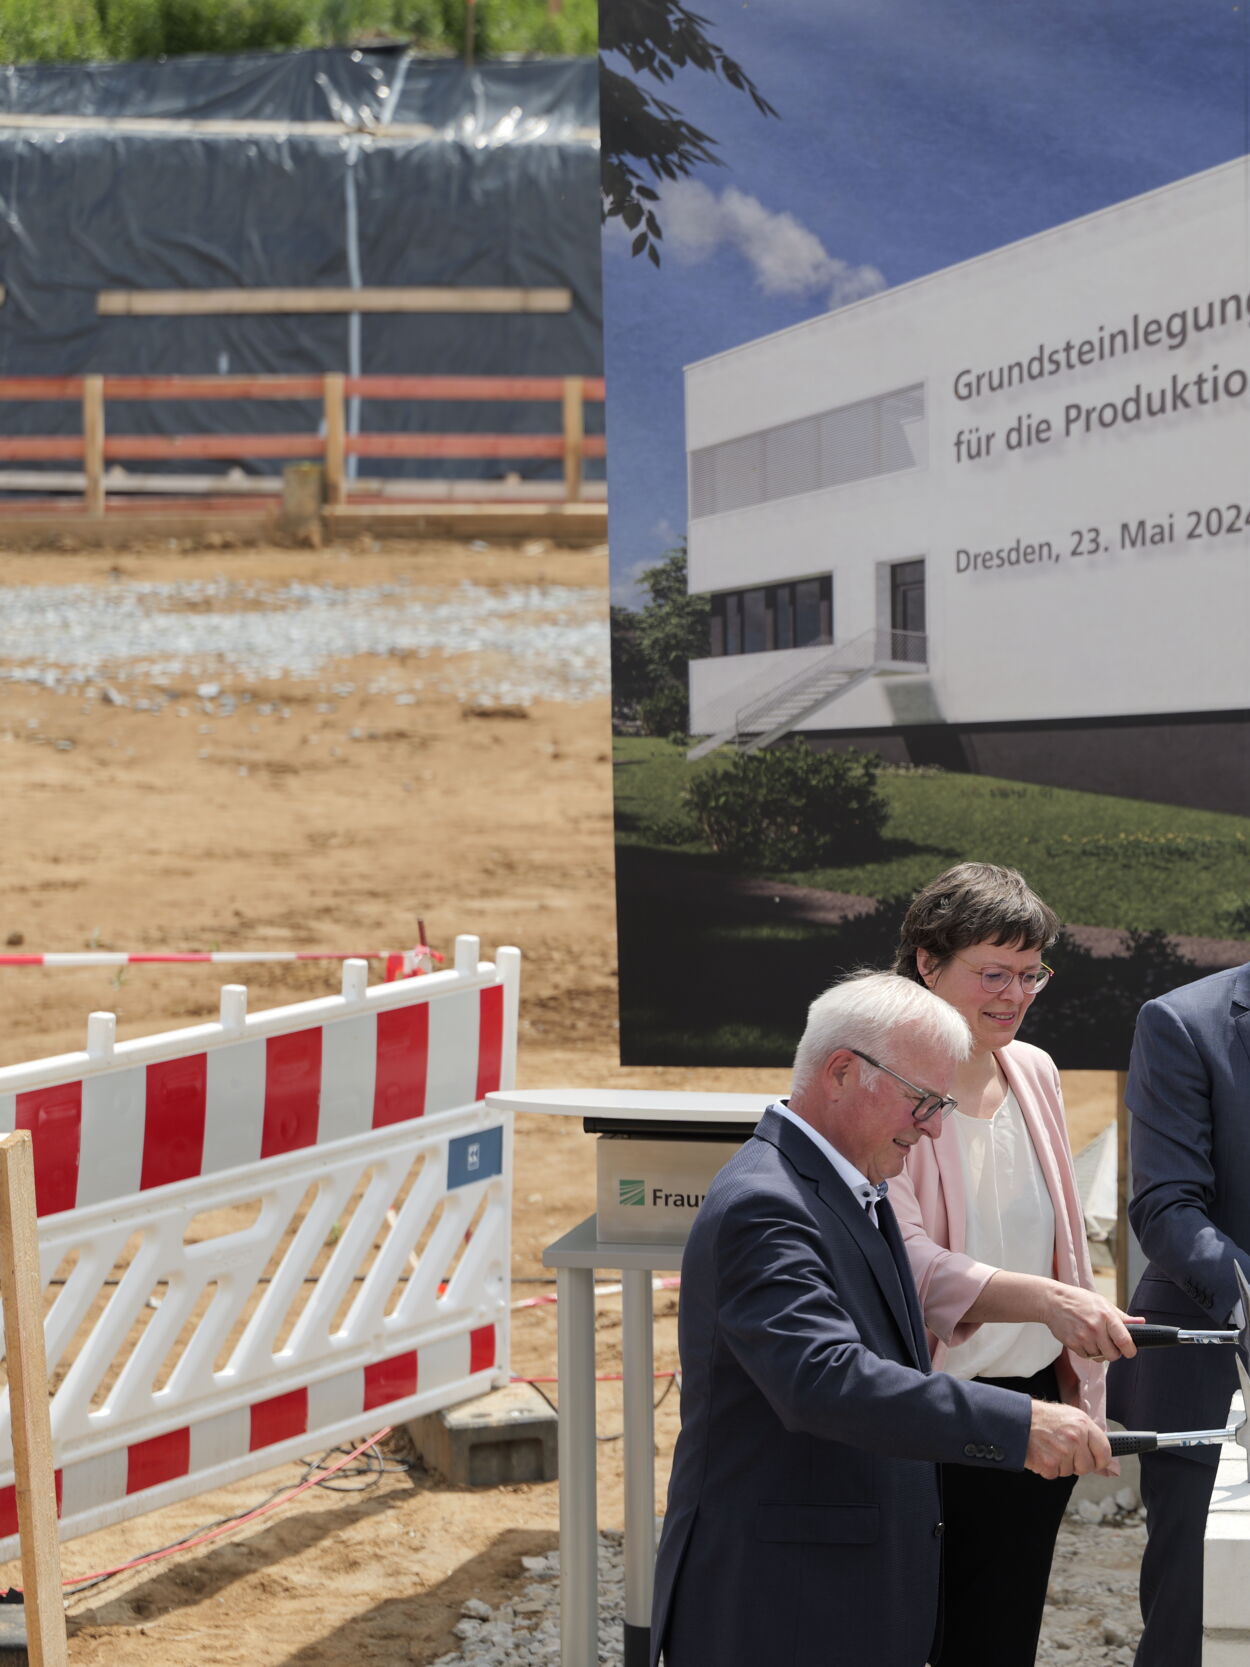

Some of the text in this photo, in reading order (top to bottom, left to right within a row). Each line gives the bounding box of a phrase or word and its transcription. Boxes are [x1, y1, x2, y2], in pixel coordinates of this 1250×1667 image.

[953, 426, 997, 464] für
[1005, 414, 1053, 451] die
[955, 540, 1061, 574] Dresden,
[1070, 527, 1109, 557] 23.
[1120, 514, 1175, 550] Mai
[652, 1188, 706, 1208] Frau
